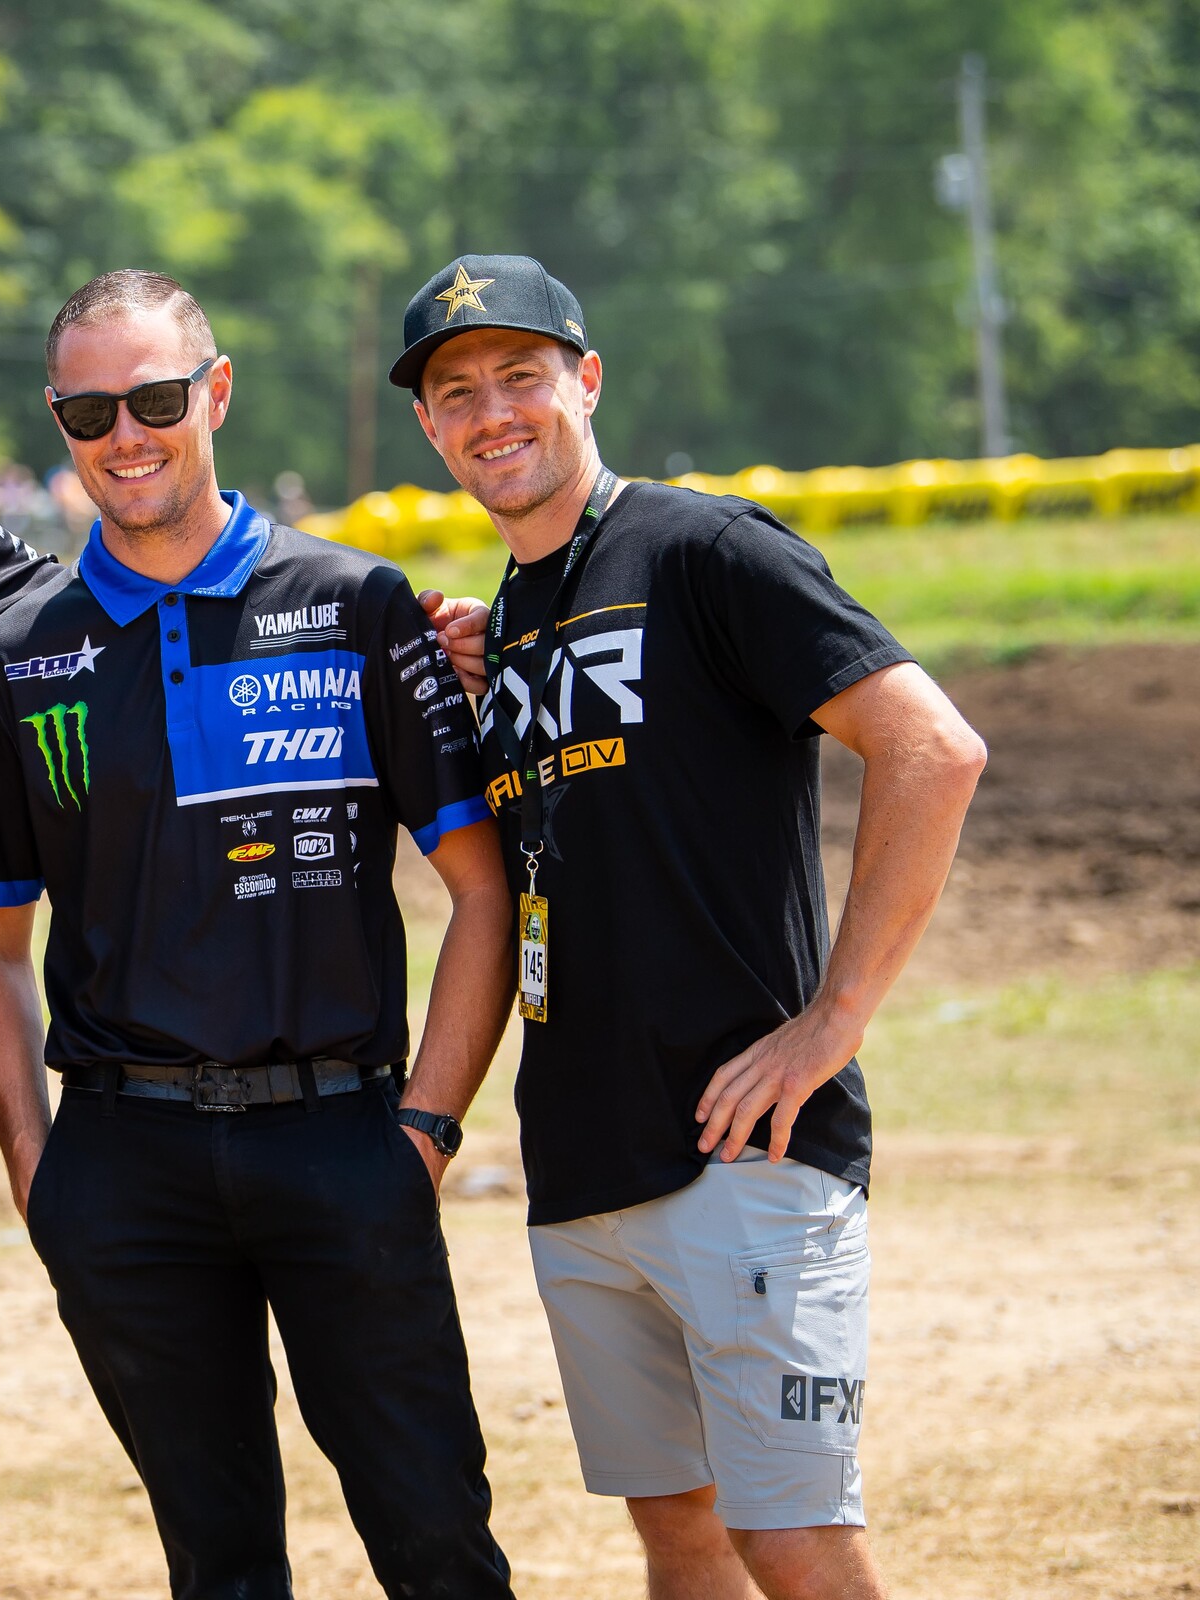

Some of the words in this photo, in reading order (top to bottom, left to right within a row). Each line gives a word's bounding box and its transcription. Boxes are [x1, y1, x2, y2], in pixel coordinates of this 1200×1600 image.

[254, 602, 341, 637] YAMALUBE
[561, 737, 626, 777] DIV
[220, 810, 274, 824] REKLUSE
[228, 843, 277, 861] FMF
[297, 838, 329, 855] 100%
[292, 870, 341, 882] PARTS
[233, 877, 276, 896] ESCONDIDO
[524, 948, 543, 984] 145
